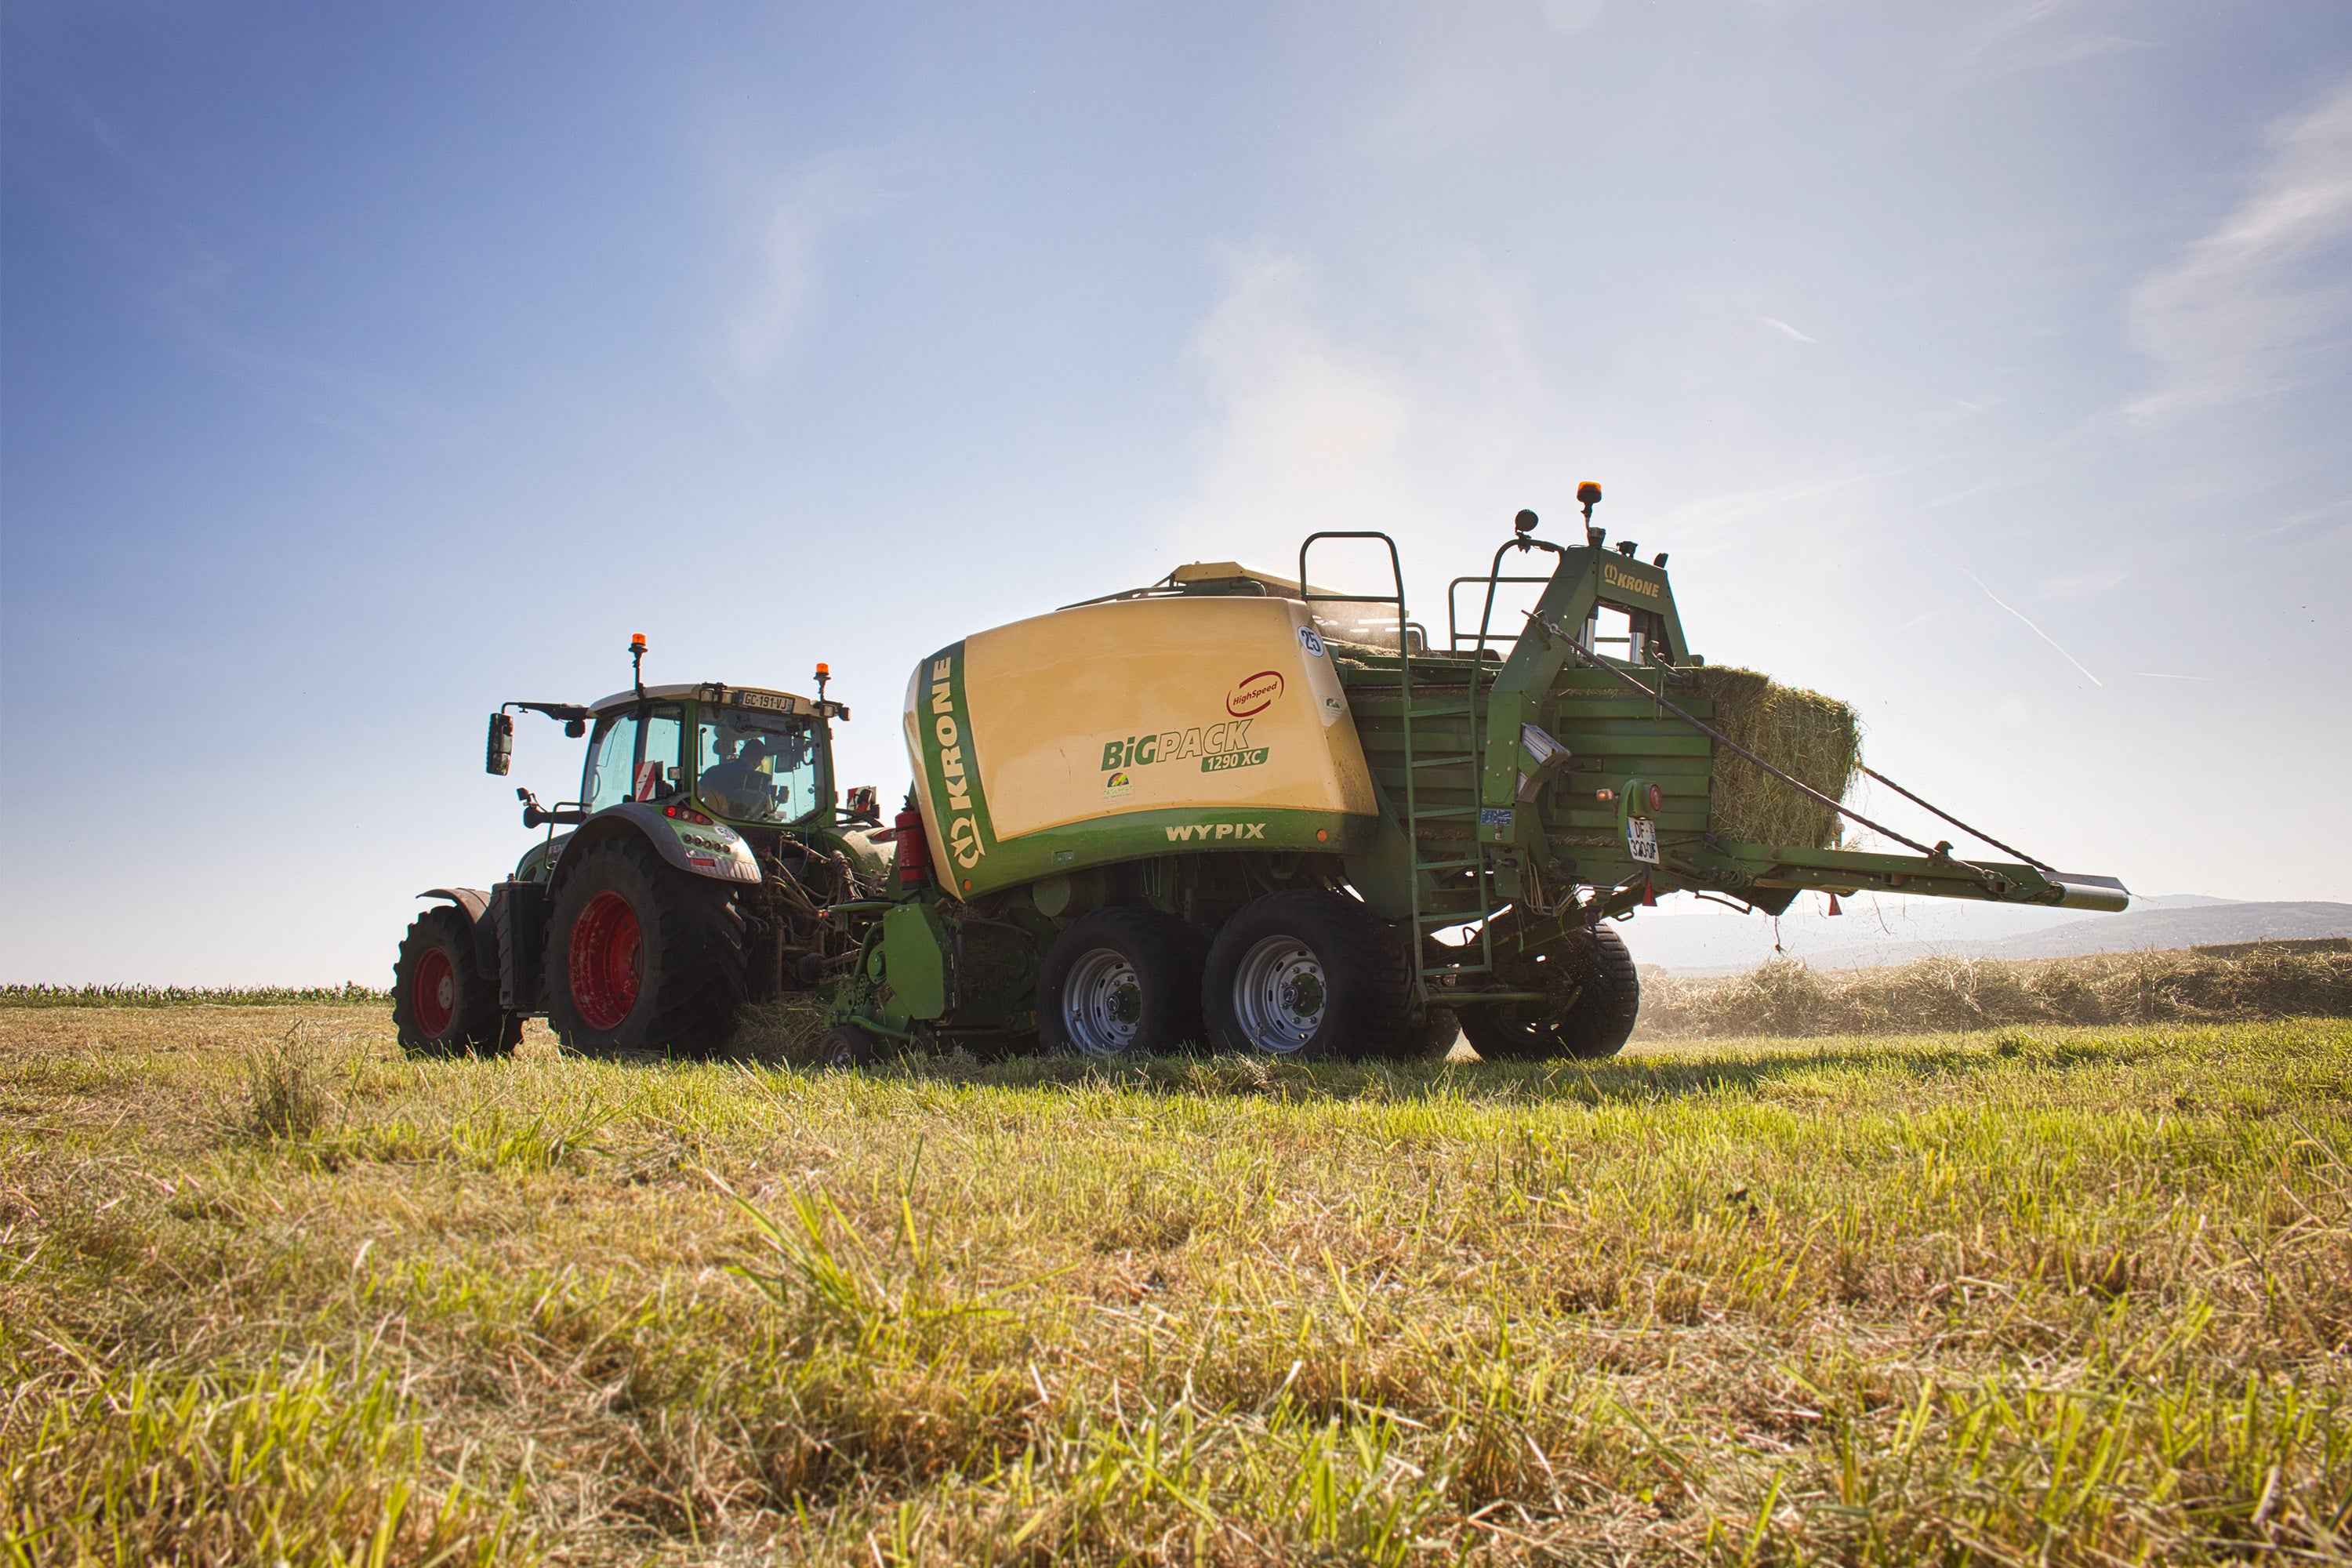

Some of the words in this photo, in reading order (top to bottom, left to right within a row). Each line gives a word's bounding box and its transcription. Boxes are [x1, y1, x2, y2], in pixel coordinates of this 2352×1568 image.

[1617, 573, 1660, 597] KRONE
[1301, 630, 1320, 652] 25
[1232, 681, 1278, 706] HighSpeed
[931, 656, 972, 811] KRONE
[1207, 755, 1237, 771] 1290
[1241, 750, 1261, 766] XC
[1165, 823, 1267, 841] WYPIX
